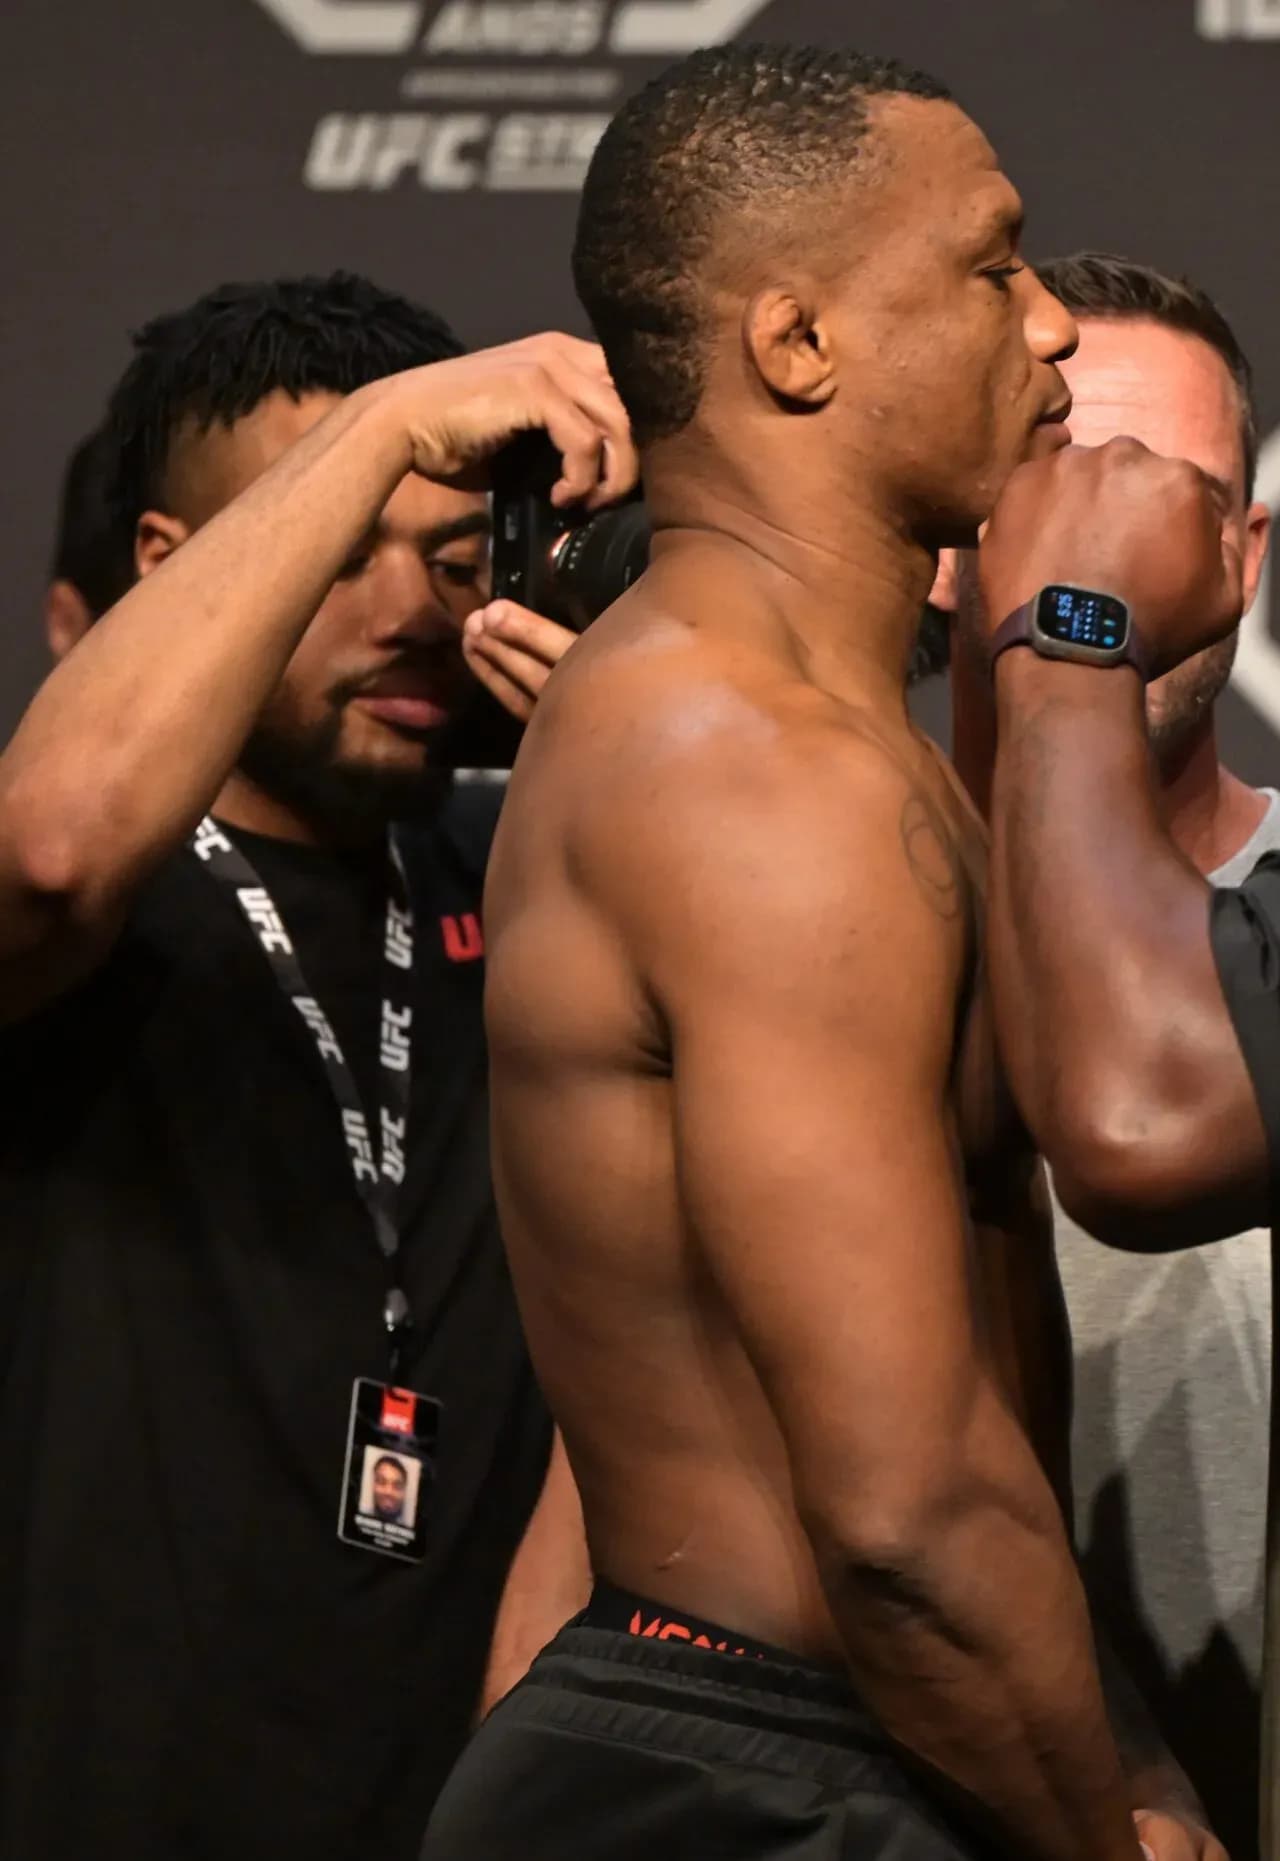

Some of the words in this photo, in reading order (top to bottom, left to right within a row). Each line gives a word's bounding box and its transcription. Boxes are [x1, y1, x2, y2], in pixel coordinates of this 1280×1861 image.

[302, 112, 492, 191] UFC
[237, 887, 293, 954] UFC
[384, 899, 413, 970] UFC
[291, 996, 344, 1064] UFC
[380, 1000, 412, 1071] UFC
[342, 1108, 379, 1184] UFC
[380, 1106, 405, 1184] UFC
